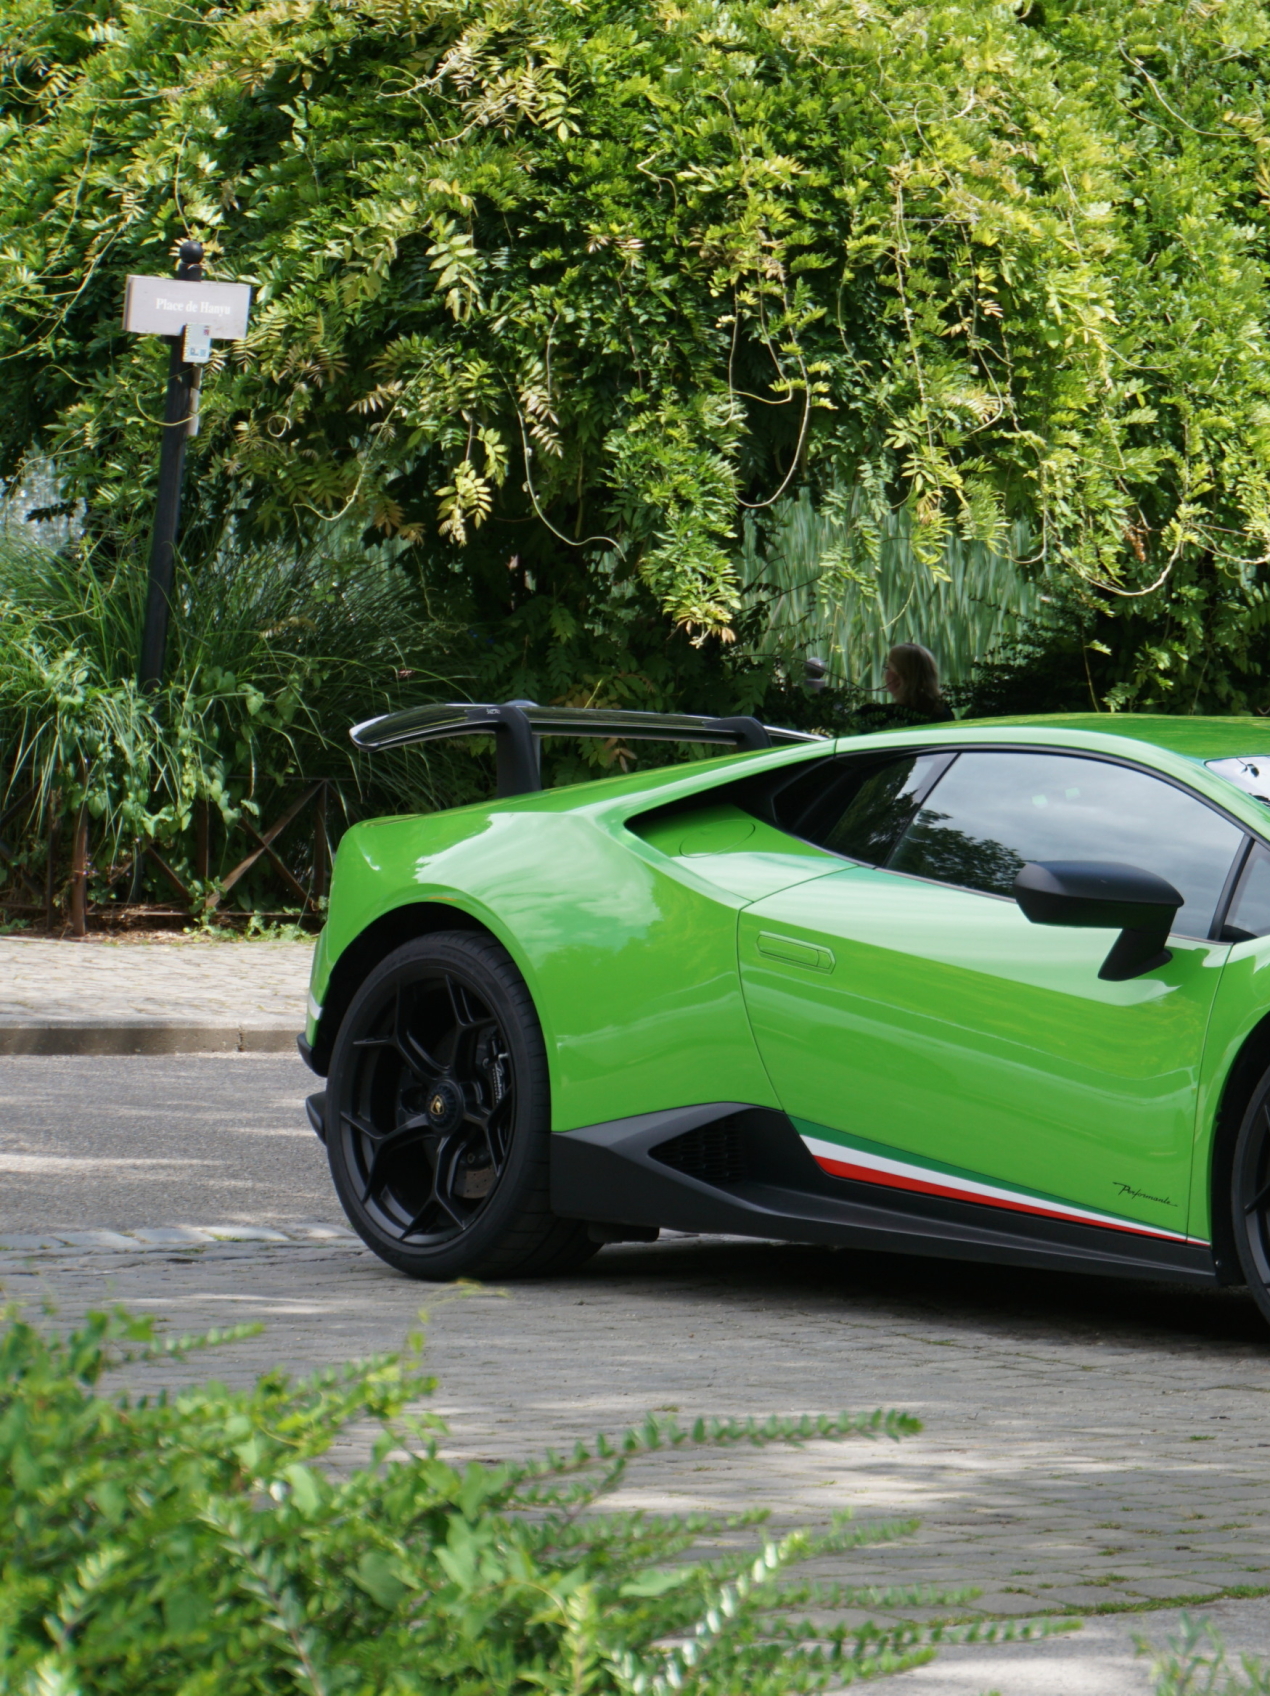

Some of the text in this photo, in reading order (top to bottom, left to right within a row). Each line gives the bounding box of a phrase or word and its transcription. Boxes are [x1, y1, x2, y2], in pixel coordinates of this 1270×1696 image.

[155, 298, 231, 317] Place de Hanyu
[1112, 1181, 1178, 1207] Performante
